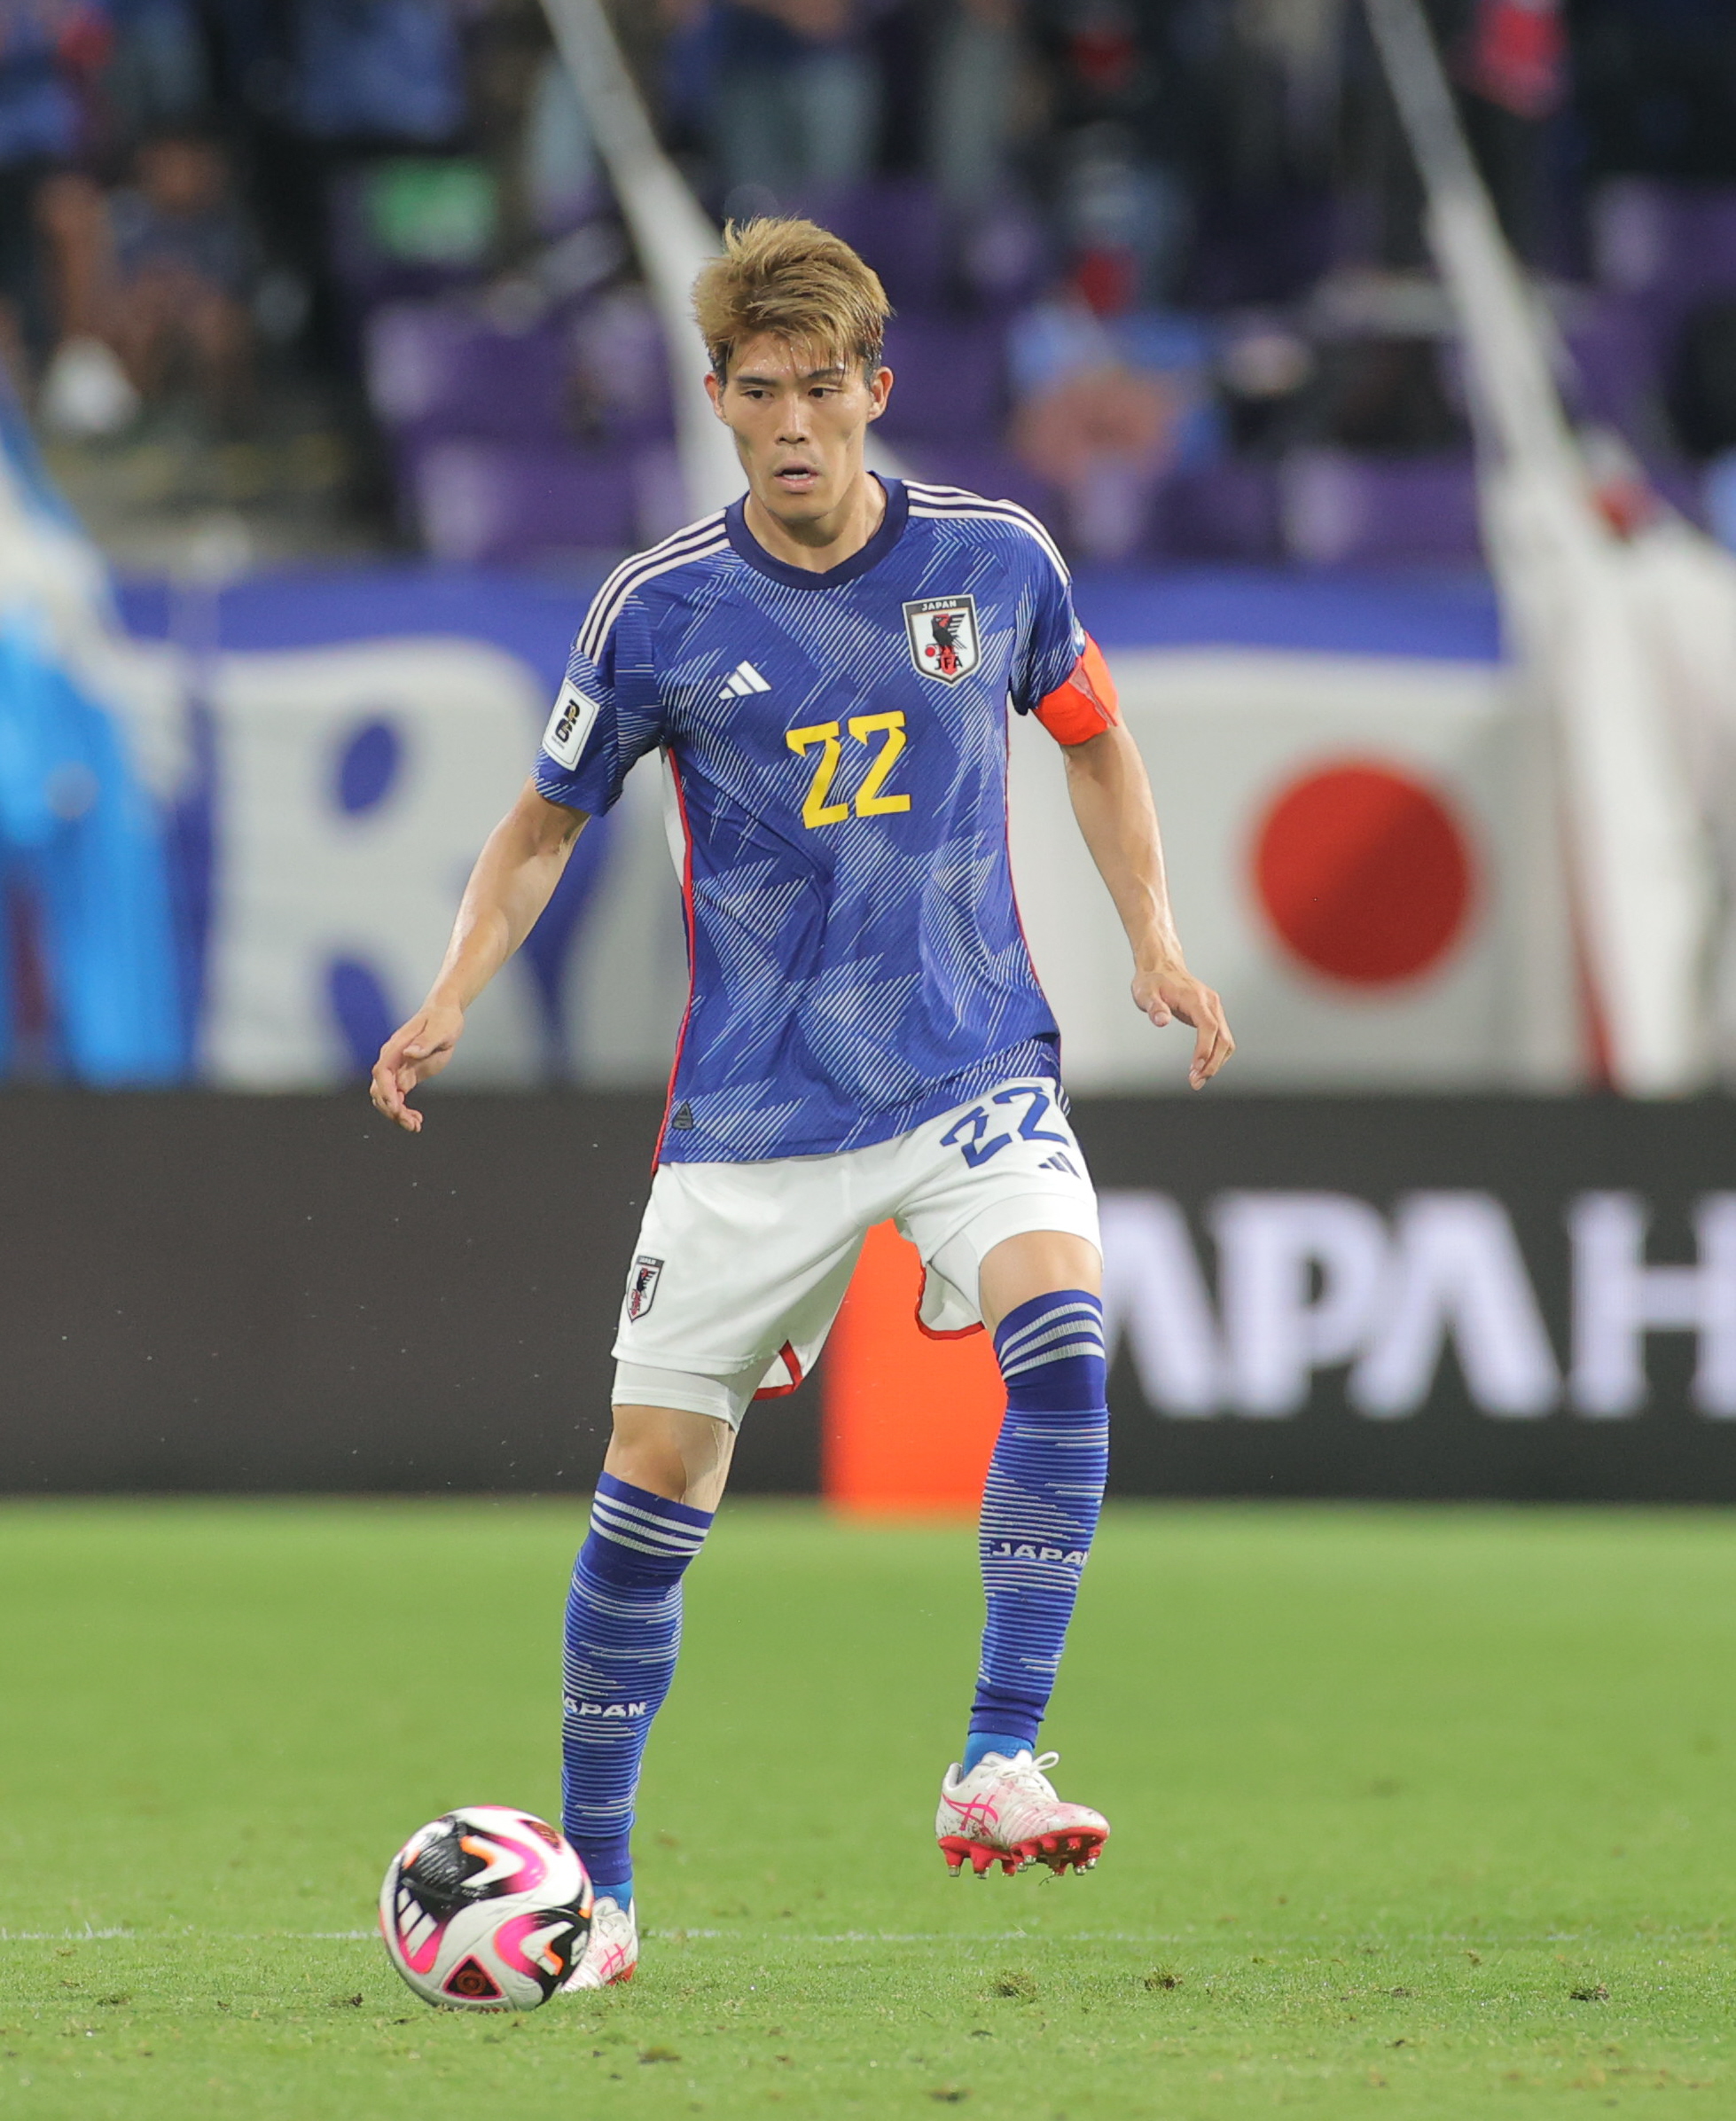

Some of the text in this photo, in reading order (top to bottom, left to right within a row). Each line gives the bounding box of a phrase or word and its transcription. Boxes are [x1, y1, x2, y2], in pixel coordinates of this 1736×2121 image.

[921, 599, 958, 612] JAPAN
[934, 656, 964, 670] JFA
[786, 709, 911, 830] 22
[939, 1085, 1071, 1170] 22
[562, 1692, 647, 1718] APAN
